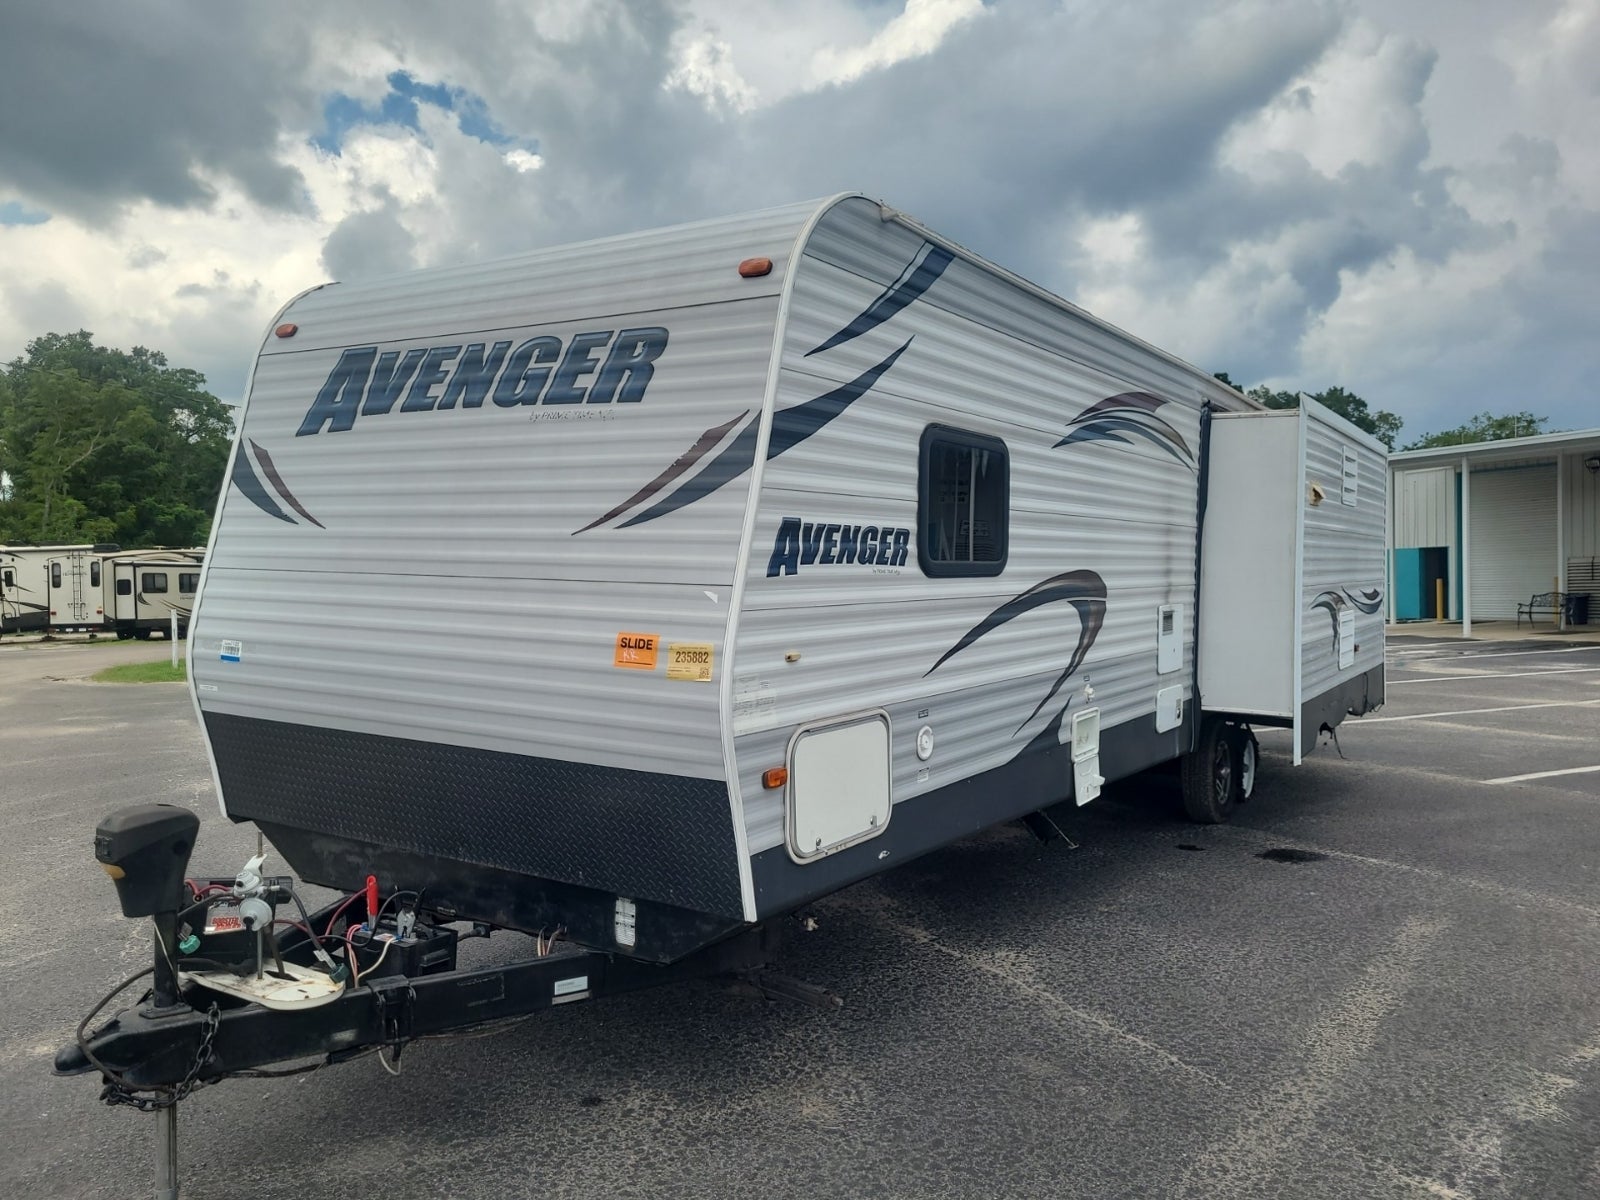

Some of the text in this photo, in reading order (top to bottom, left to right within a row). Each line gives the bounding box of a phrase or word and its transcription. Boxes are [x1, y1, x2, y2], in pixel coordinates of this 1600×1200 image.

[296, 327, 670, 437] AVENGER
[766, 516, 911, 578] AVENGER
[620, 636, 654, 651] SLIDE
[675, 651, 710, 664] 235882
